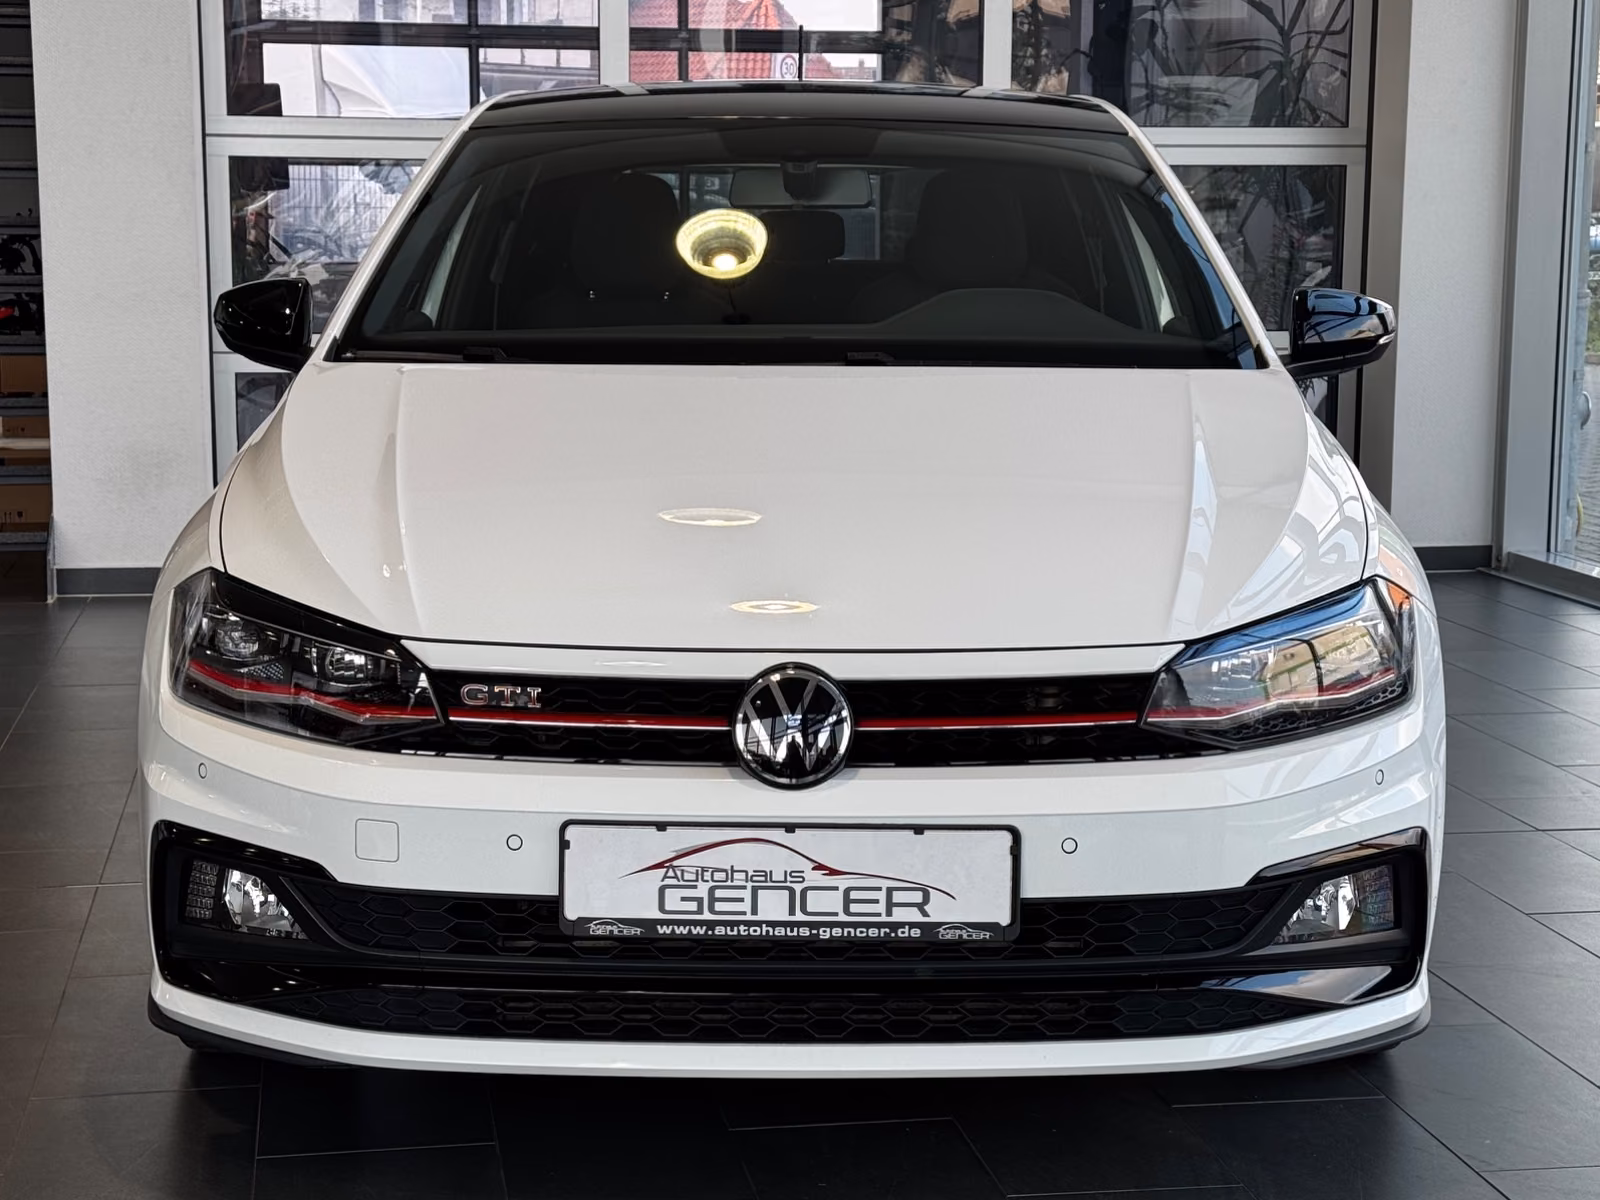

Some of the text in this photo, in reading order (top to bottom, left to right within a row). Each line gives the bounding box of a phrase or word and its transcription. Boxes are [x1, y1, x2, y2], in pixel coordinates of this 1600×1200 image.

[784, 62, 795, 75] 30
[461, 684, 541, 708] GTI
[661, 864, 805, 883] Autohaus
[658, 884, 931, 917] GENCER
[656, 924, 921, 939] www.autohaus-gencer.de
